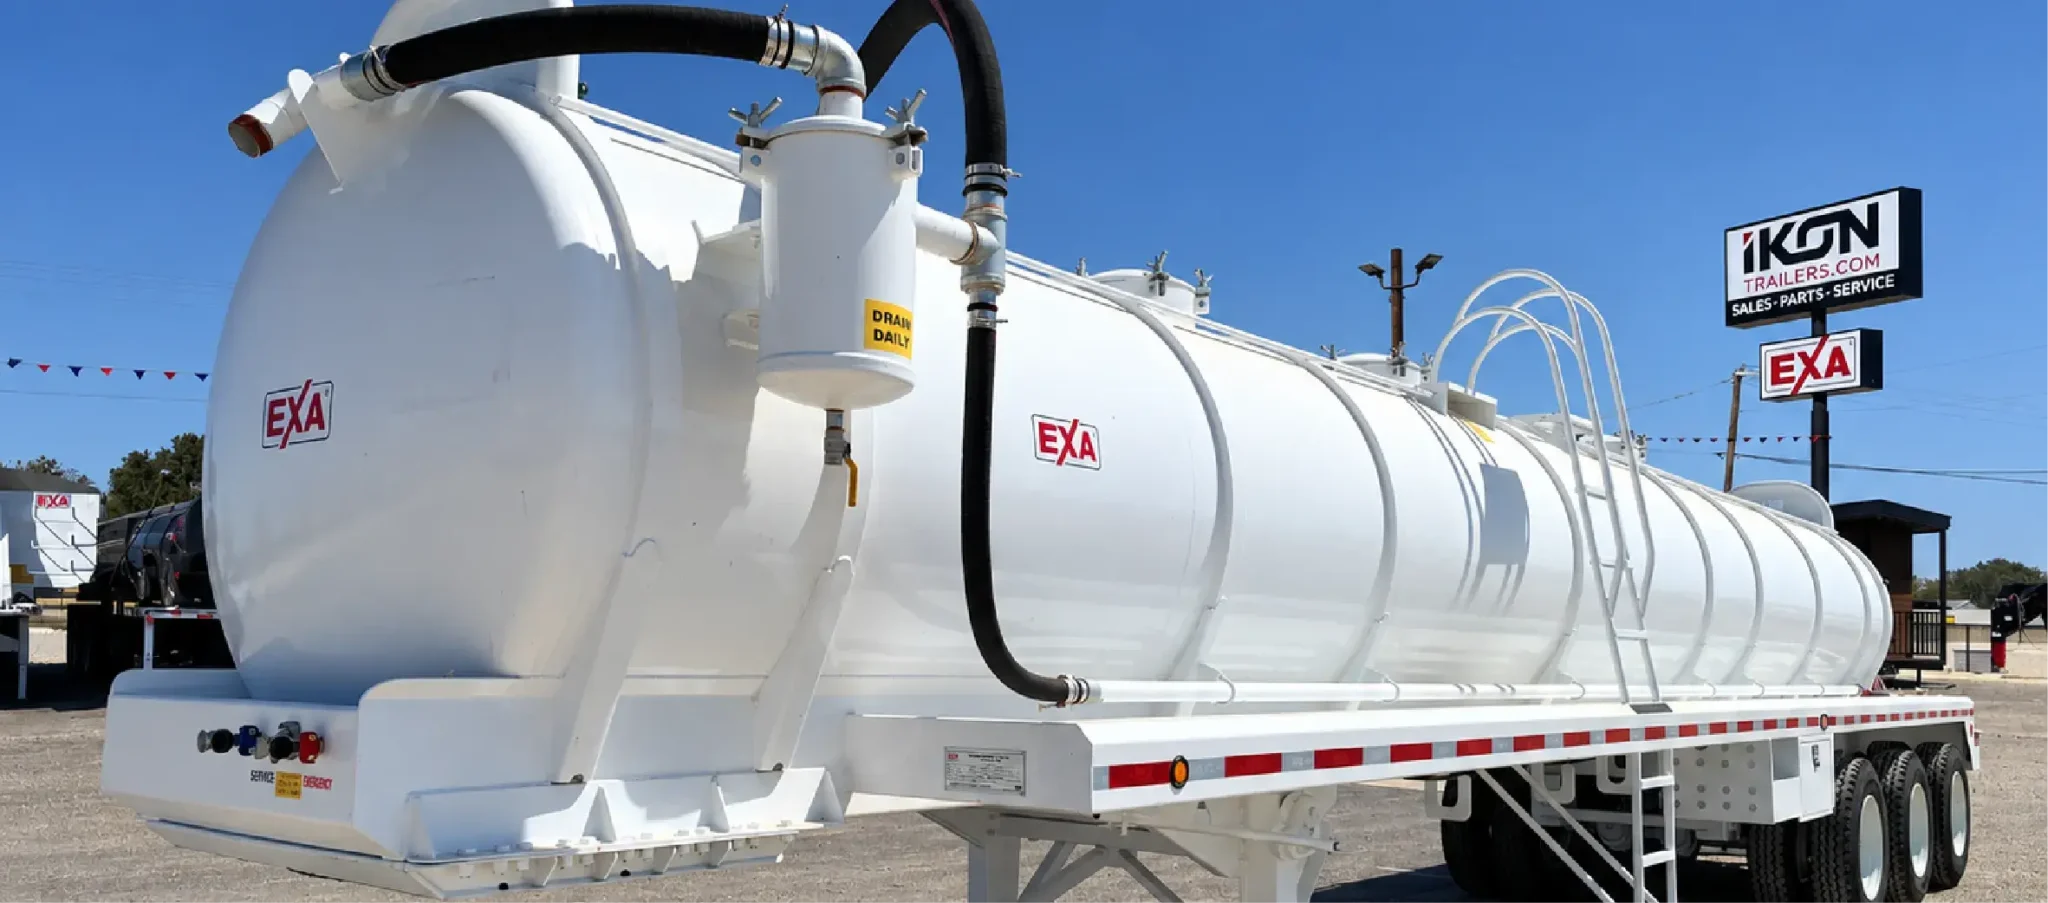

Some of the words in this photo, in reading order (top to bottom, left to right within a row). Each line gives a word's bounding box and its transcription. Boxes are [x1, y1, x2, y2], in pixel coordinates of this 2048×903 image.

[1732, 297, 1772, 317] SALES
[1779, 287, 1824, 308] PARTS
[1833, 273, 1895, 298] SERVICE
[1743, 253, 1881, 293] TRAILERS.COM
[872, 309, 912, 330] DRAIN
[873, 328, 910, 349] DAILY
[1770, 335, 1851, 395] EXA
[266, 379, 325, 449] EXA
[1038, 418, 1097, 466] EXA
